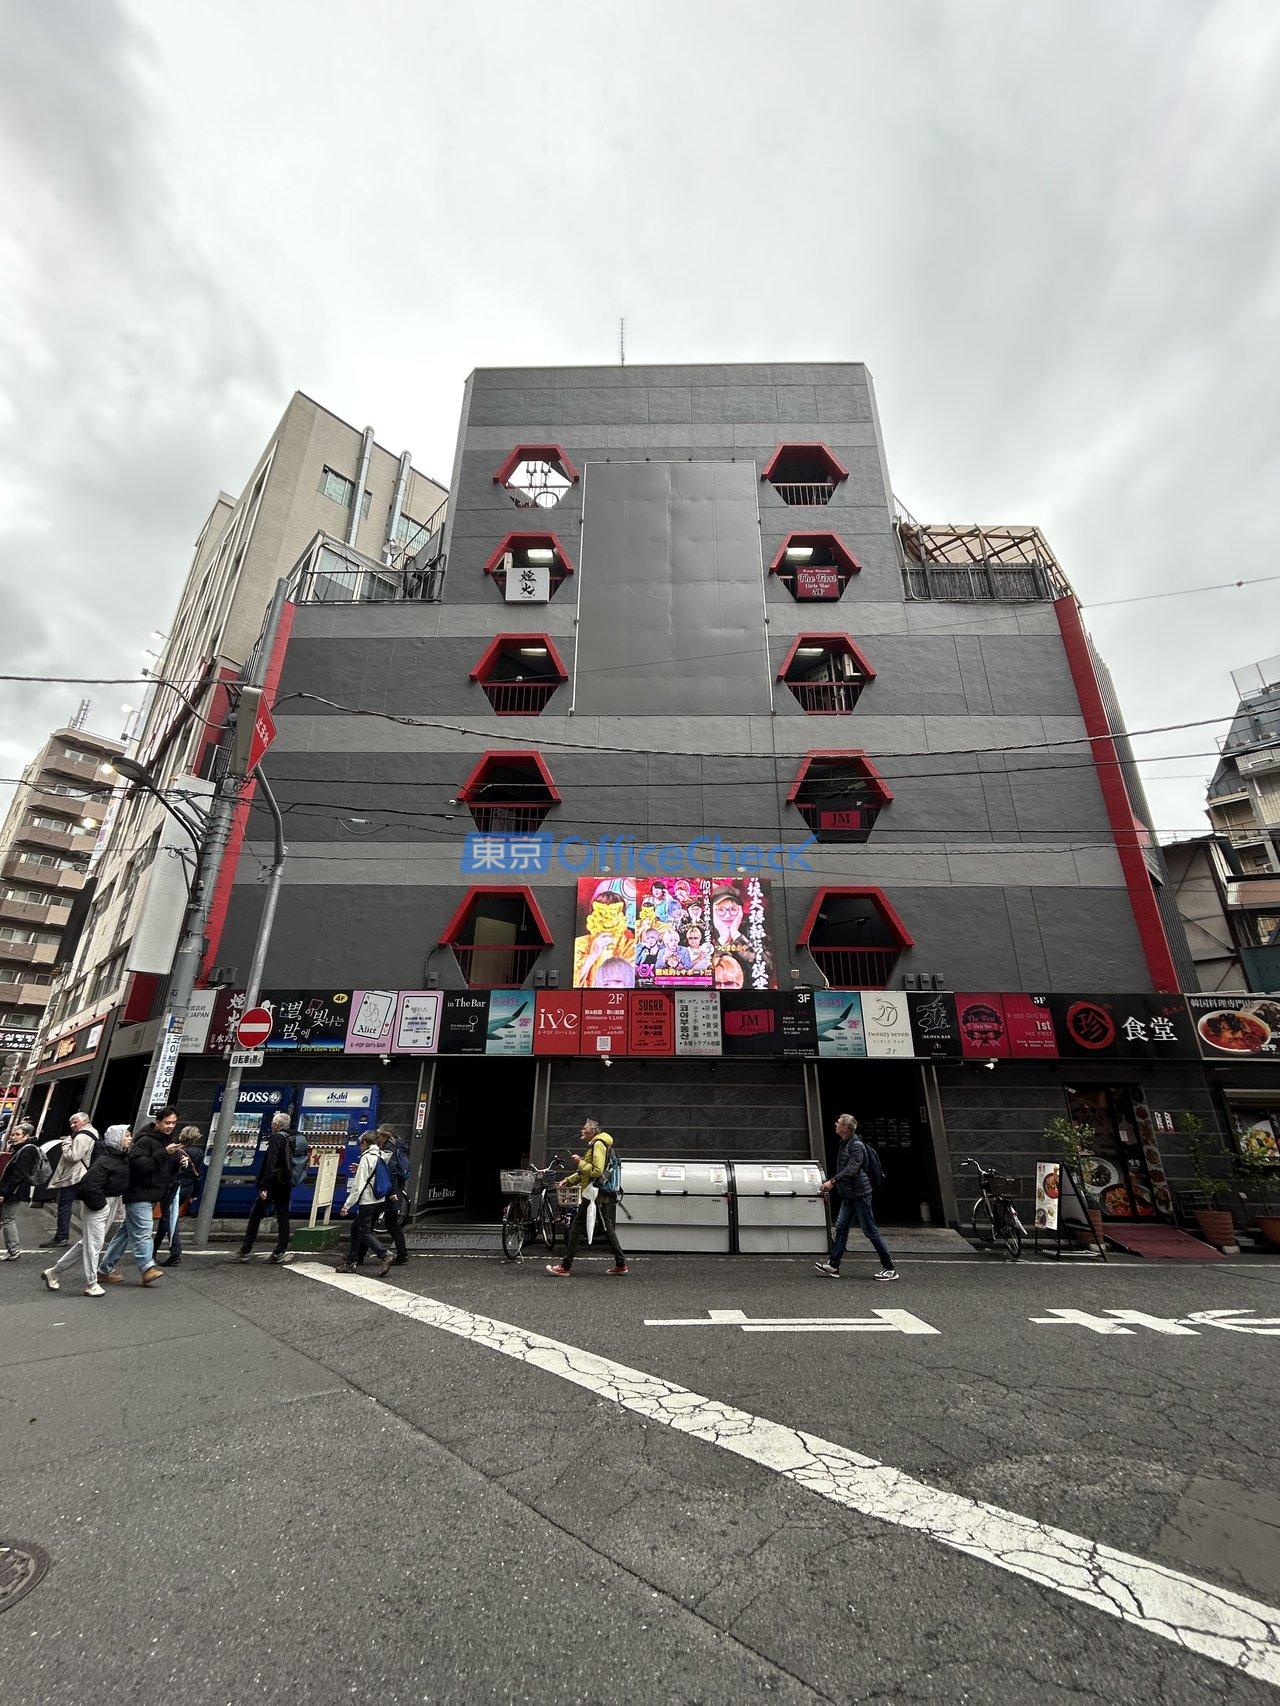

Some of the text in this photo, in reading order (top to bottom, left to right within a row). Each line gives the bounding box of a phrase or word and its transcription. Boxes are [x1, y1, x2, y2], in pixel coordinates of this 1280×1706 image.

[798, 573, 837, 583] The First
[832, 813, 850, 826] JM
[455, 997, 471, 1008] The
[471, 998, 486, 1008] Bar
[608, 993, 624, 1004] 2F
[797, 993, 811, 1004] 3F
[1033, 996, 1047, 1004] 5F
[639, 999, 664, 1012] SUGAR
[518, 1018, 532, 1027] 2F
[538, 1008, 578, 1029] ive
[739, 1014, 759, 1028] JM
[847, 1019, 861, 1029] 2F
[357, 1024, 377, 1034] Alice
[1035, 1020, 1052, 1031] 1st
[1121, 1016, 1178, 1042] 食堂
[232, 1056, 262, 1065] 自転車を除く
[238, 1090, 269, 1103] BOSS
[327, 1091, 348, 1100] Asahi
[442, 1187, 456, 1198] Bar
